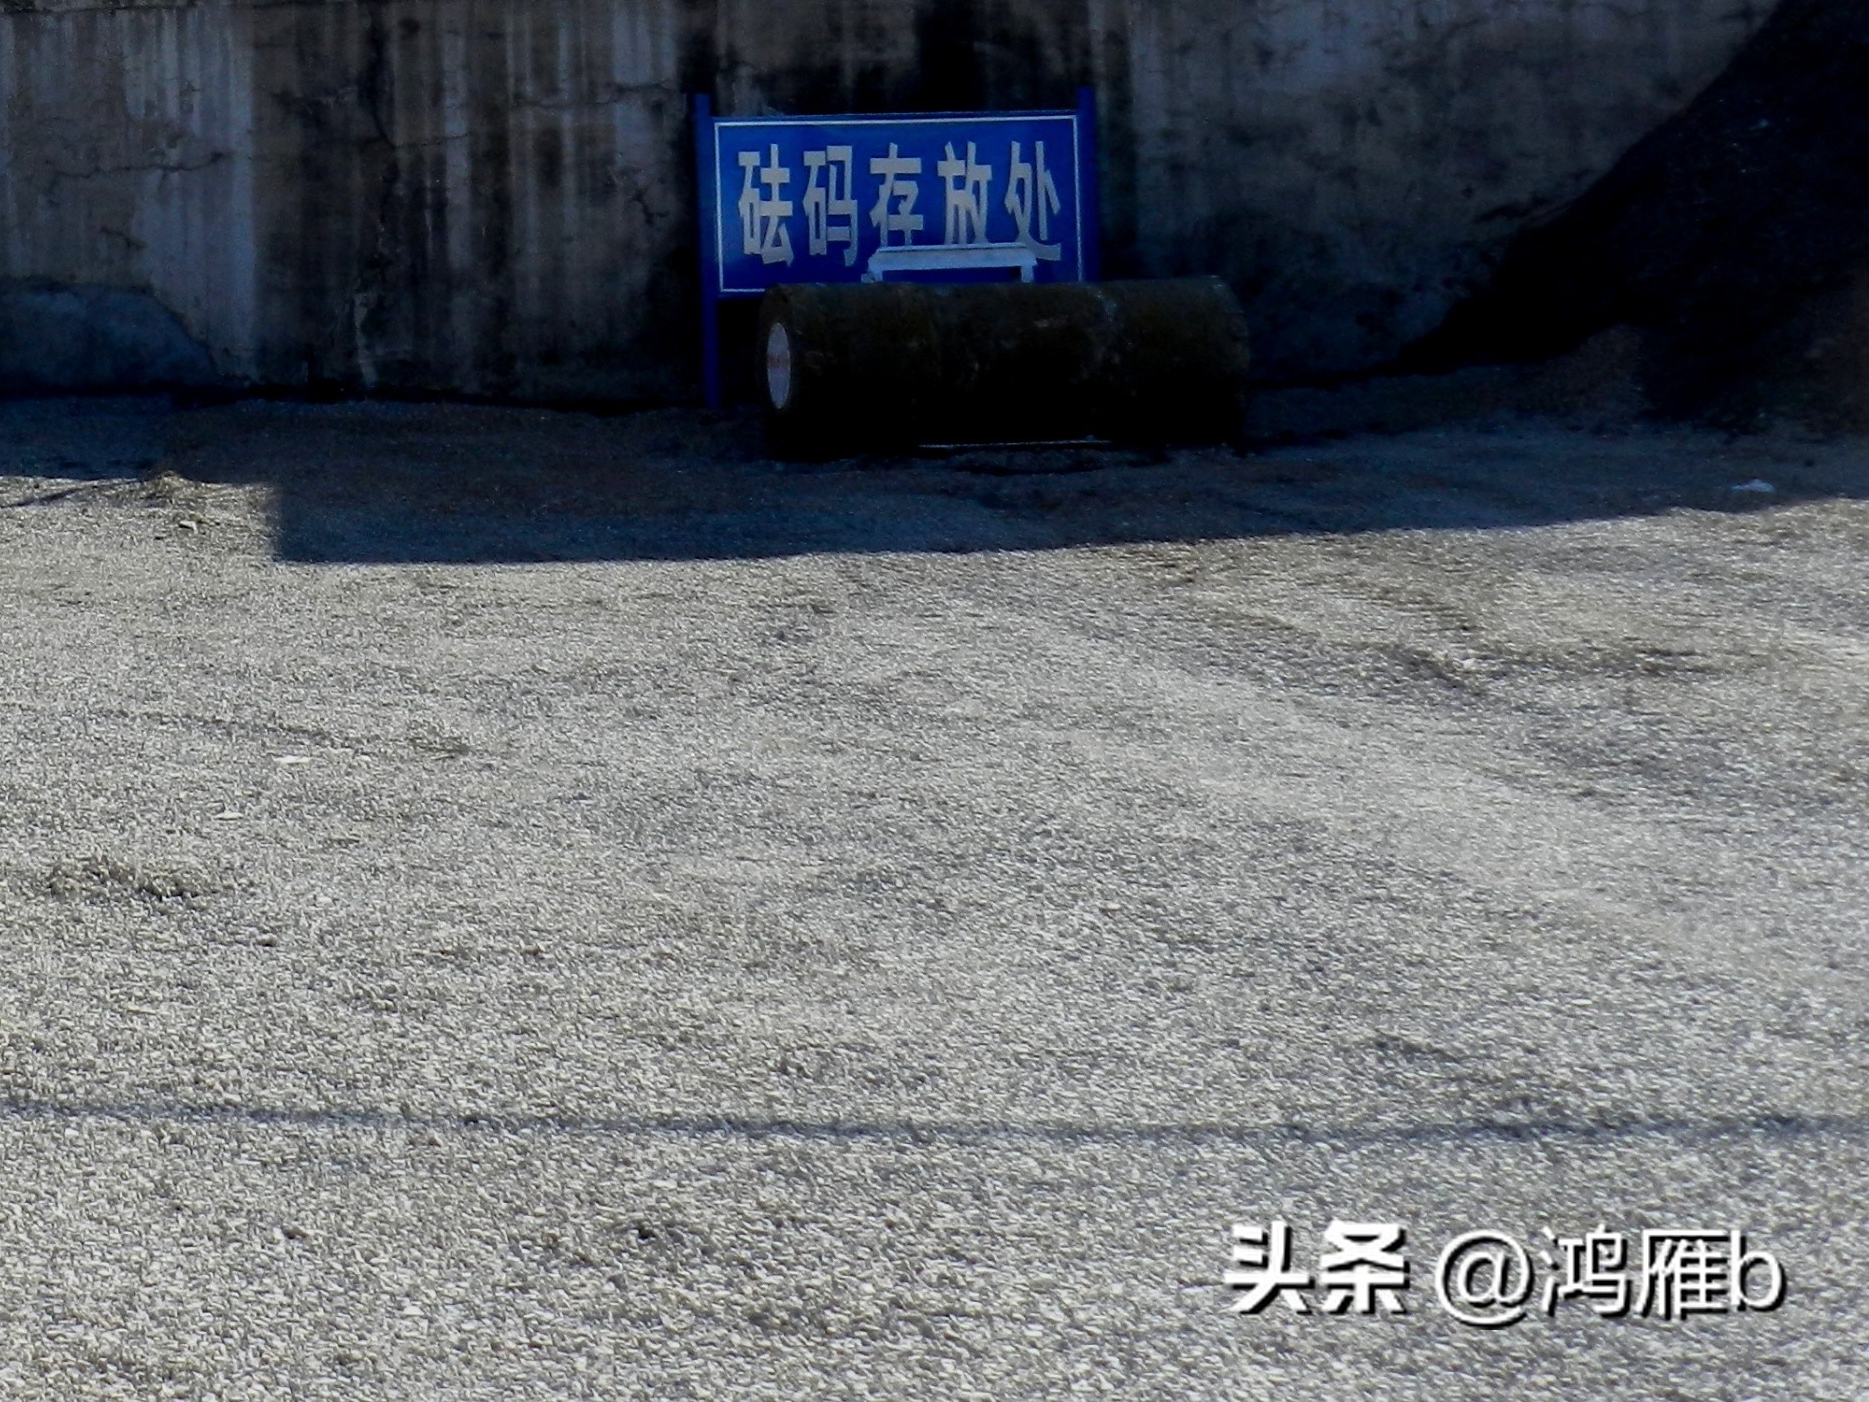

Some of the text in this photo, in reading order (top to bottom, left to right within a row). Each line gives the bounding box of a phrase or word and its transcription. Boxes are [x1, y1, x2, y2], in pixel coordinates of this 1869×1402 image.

[737, 140, 1062, 267] 砝码存放处
